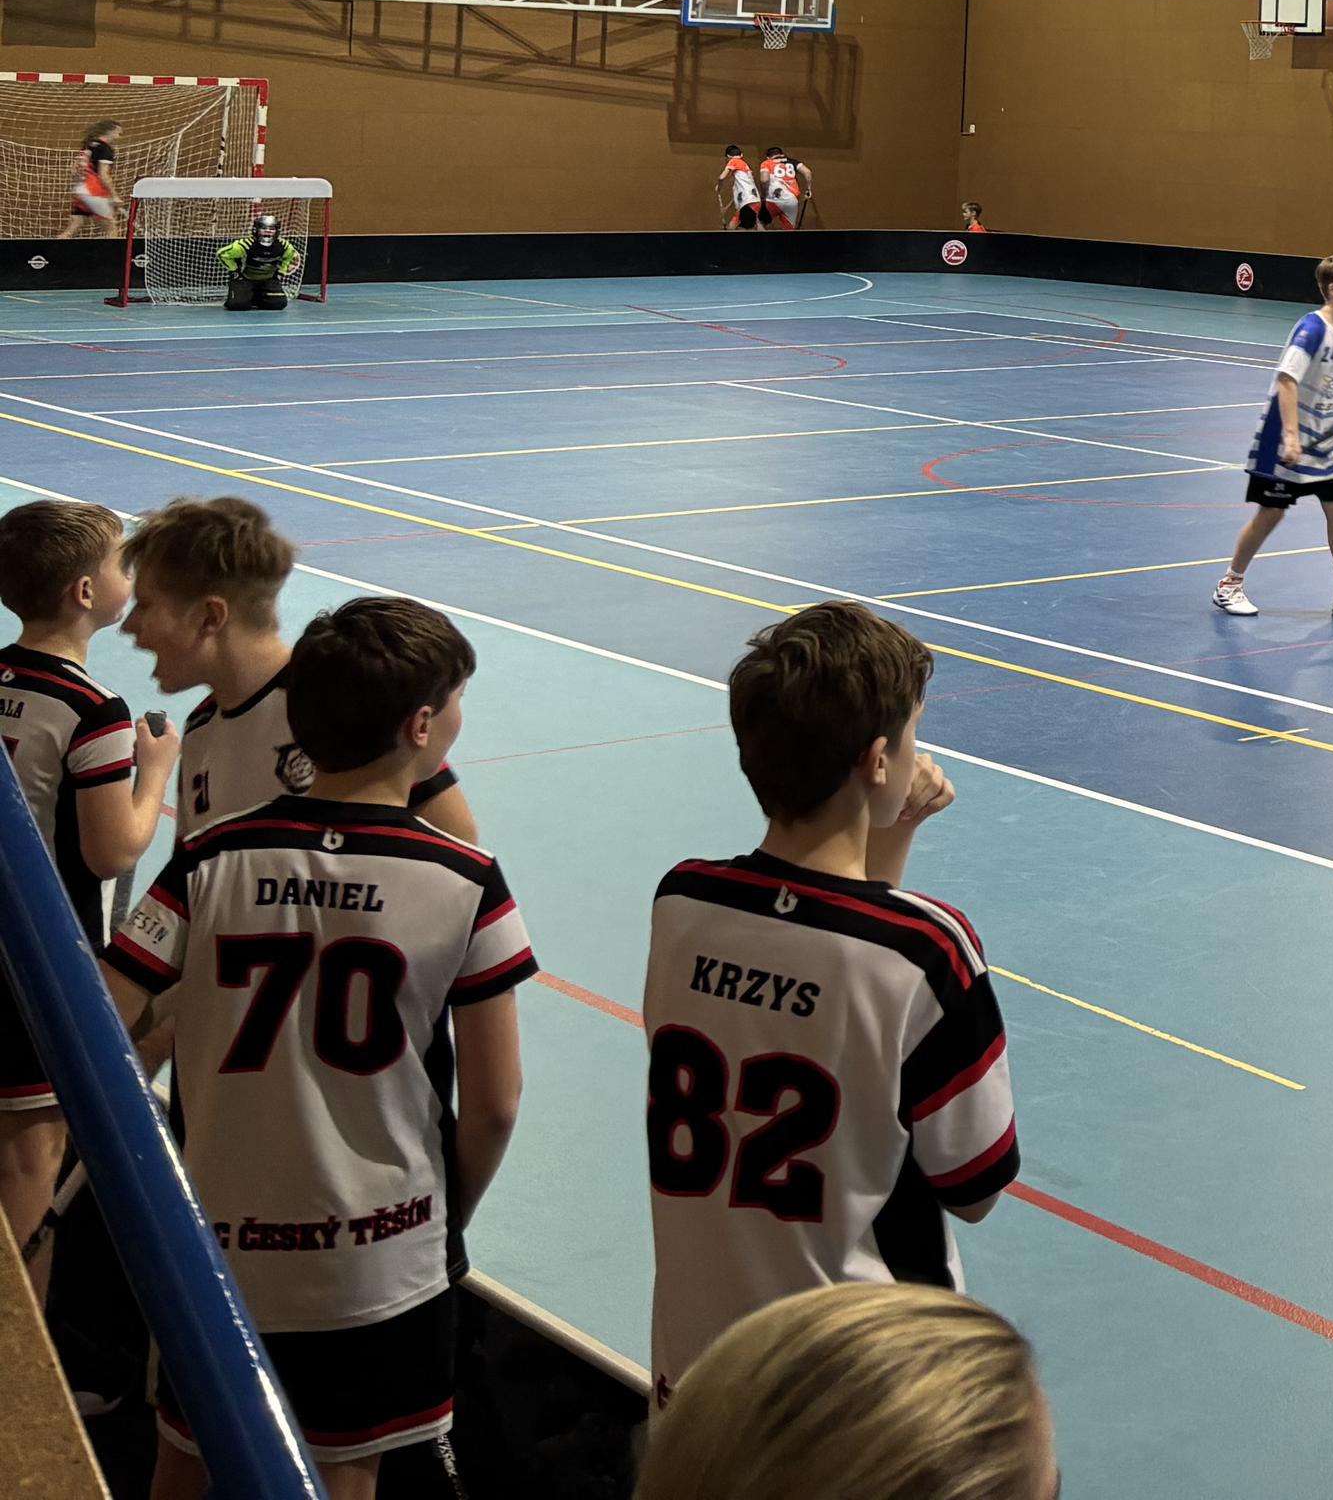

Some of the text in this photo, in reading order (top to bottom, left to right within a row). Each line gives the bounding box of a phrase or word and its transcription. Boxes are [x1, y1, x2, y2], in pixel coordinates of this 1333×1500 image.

[255, 877, 385, 913] DANIEL
[216, 932, 407, 1076] 70
[689, 955, 821, 1017] KRZYS
[647, 1023, 841, 1224] 82
[238, 1216, 341, 1252] ČESKÝ
[348, 1194, 433, 1246] TĚŠÍN
